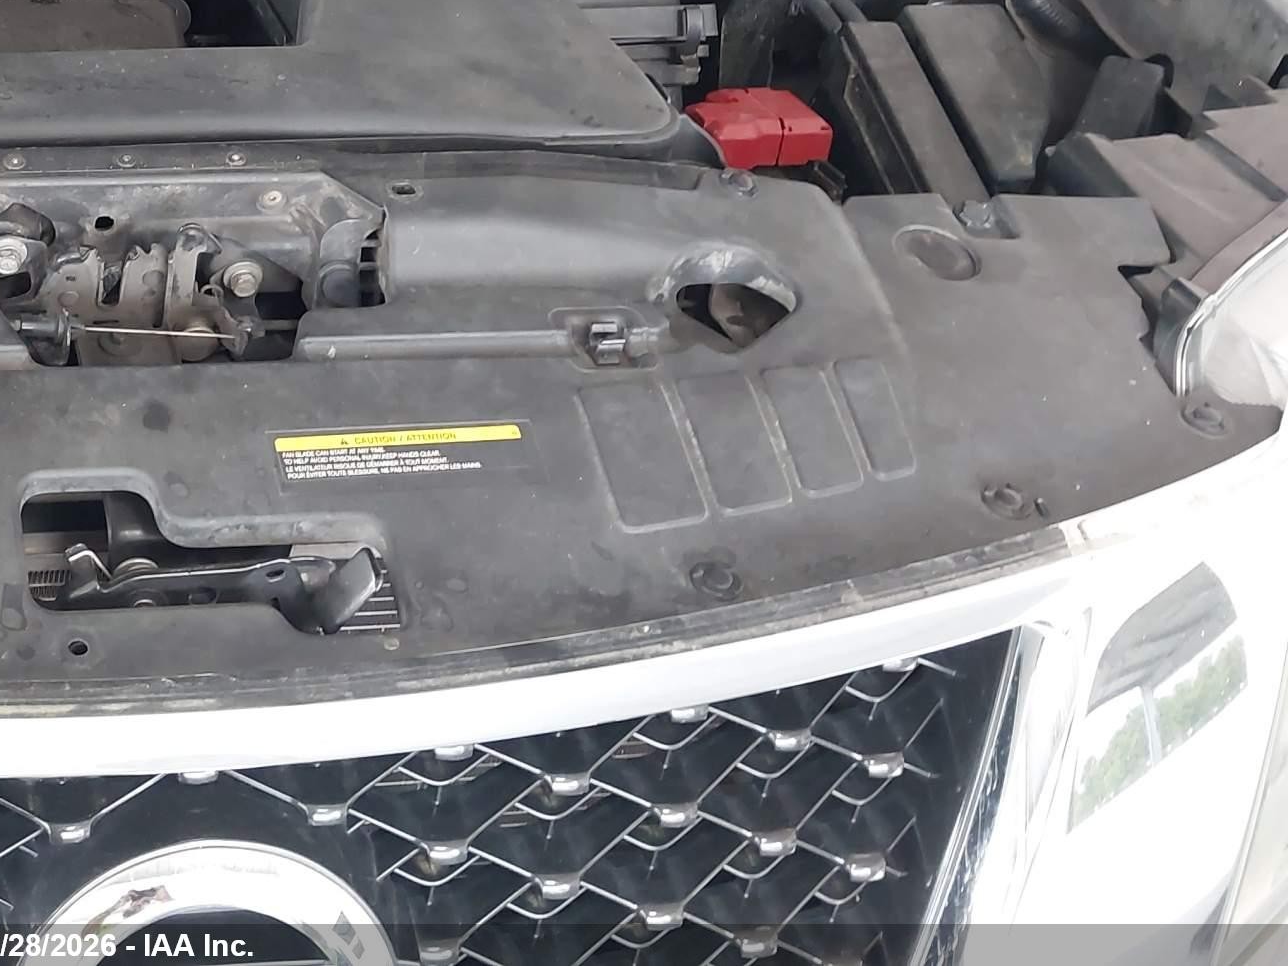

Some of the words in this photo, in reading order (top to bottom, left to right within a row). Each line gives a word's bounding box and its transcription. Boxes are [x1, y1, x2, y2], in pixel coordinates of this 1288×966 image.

[355, 435, 396, 445] CAUTION
[407, 432, 456, 442] ATTENTION
[287, 472, 306, 480] POUR
